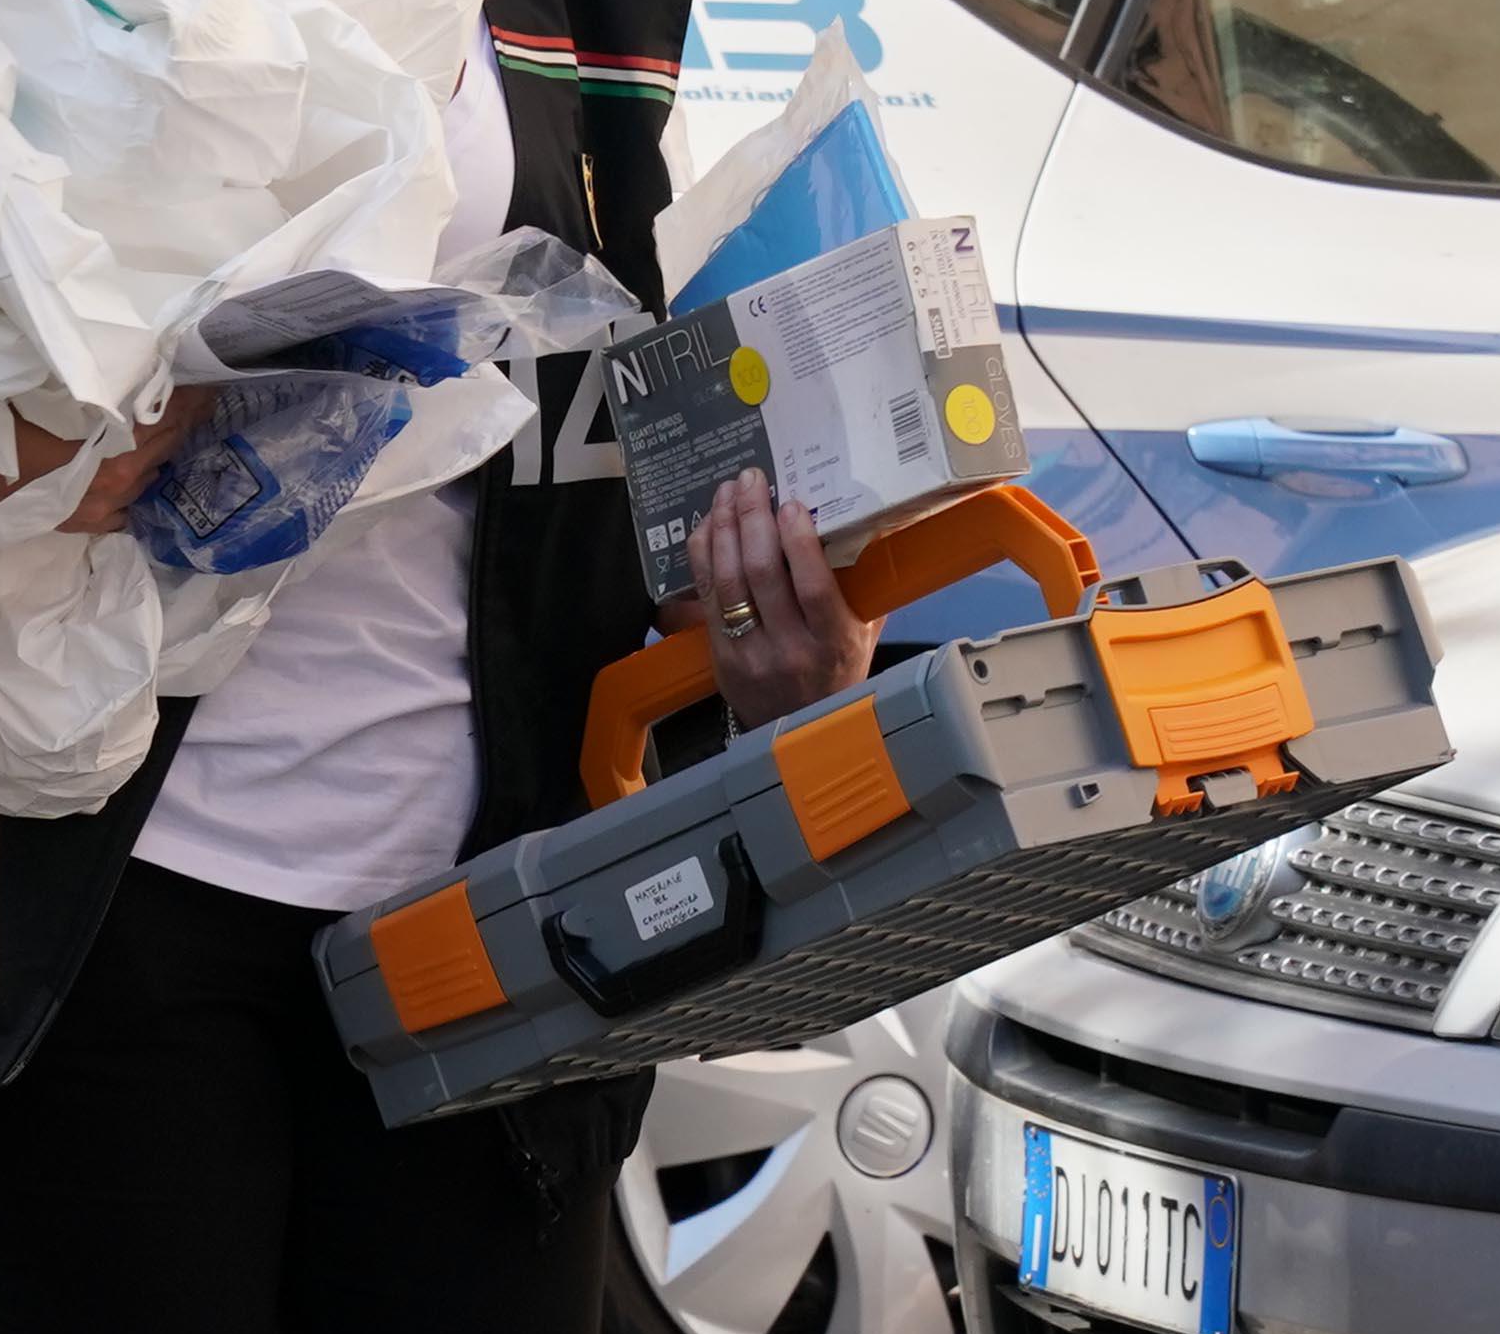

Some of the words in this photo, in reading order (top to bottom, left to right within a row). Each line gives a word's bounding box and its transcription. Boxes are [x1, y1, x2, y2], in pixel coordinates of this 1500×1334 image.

[950, 227, 990, 335] NITRIL
[930, 313, 949, 355] SMALL
[611, 321, 731, 405] NITRIL
[984, 356, 1022, 459] GLOVES
[630, 438, 647, 454] 100
[634, 871, 682, 904] MATERIALE
[653, 893, 669, 906] PER
